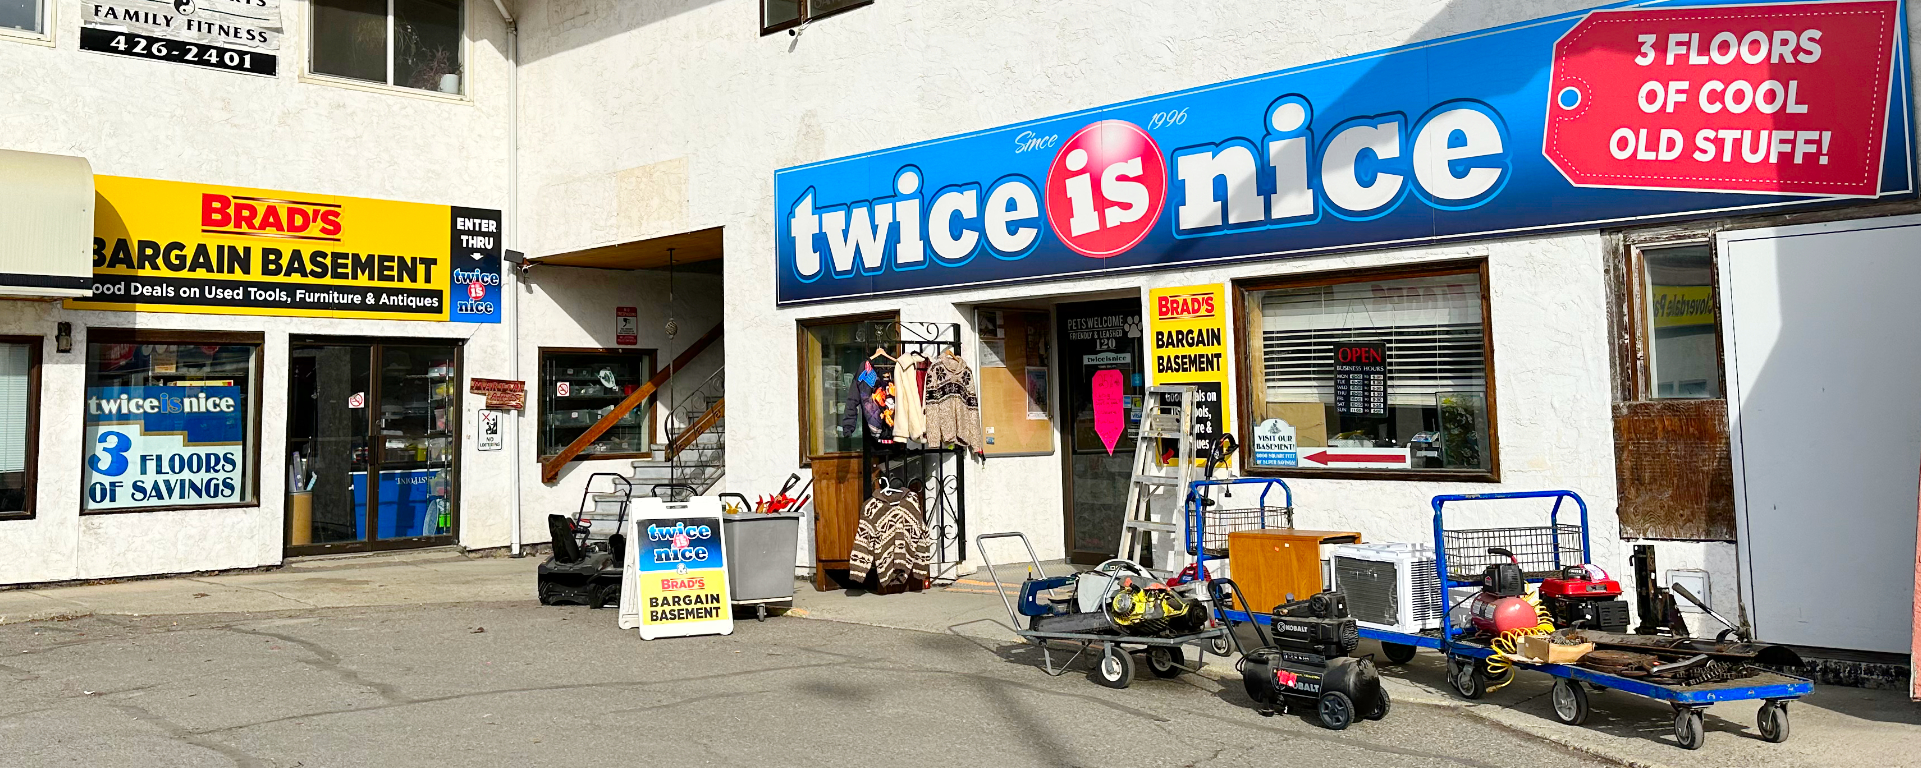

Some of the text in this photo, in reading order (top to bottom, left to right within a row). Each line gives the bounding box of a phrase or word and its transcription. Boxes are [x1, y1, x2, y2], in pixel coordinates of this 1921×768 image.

[93, 4, 268, 43] FAMILY FITNESS
[109, 35, 251, 69] 426-2401
[1634, 29, 1823, 66] 3 FLOORS
[1637, 80, 1809, 114] OF COOL
[1147, 106, 1190, 130] 1996
[1014, 130, 1059, 154] Since
[1609, 127, 1832, 165] OLD STUFF!
[790, 101, 1504, 278] twice is nice
[201, 192, 342, 236] BRAD'S
[456, 217, 497, 233] ENTER
[460, 235, 494, 249] THRU
[92, 237, 438, 284] BARGAIN BASEMENT
[453, 268, 500, 286] twice
[92, 282, 439, 309] ood Deals on Used Tools, Furniture & Antiques
[471, 285, 483, 296] is
[457, 298, 494, 314] nice
[1157, 295, 1215, 317] BRAD'S
[1067, 315, 1124, 331] PETS WELCOME
[1069, 331, 1093, 340] FRIENDLY
[1099, 329, 1123, 339] LEASHED
[1096, 337, 1117, 350] 120
[1155, 327, 1222, 349] BARGAIN
[1157, 352, 1222, 373] BASEMENT
[1338, 347, 1382, 362] OPEN
[1206, 391, 1217, 402] on
[87, 430, 237, 477] 3 FLOORS
[88, 477, 236, 503] OF SAVINGS
[647, 522, 711, 541] twice
[675, 535, 687, 547] is
[654, 545, 709, 563] nice
[676, 563, 688, 575] &
[661, 577, 705, 590] BRAD'S
[649, 593, 721, 608] BARGAIN
[650, 606, 721, 622] BASEMENT
[1285, 625, 1308, 633] KOBALT
[1294, 682, 1320, 692] OBALT
